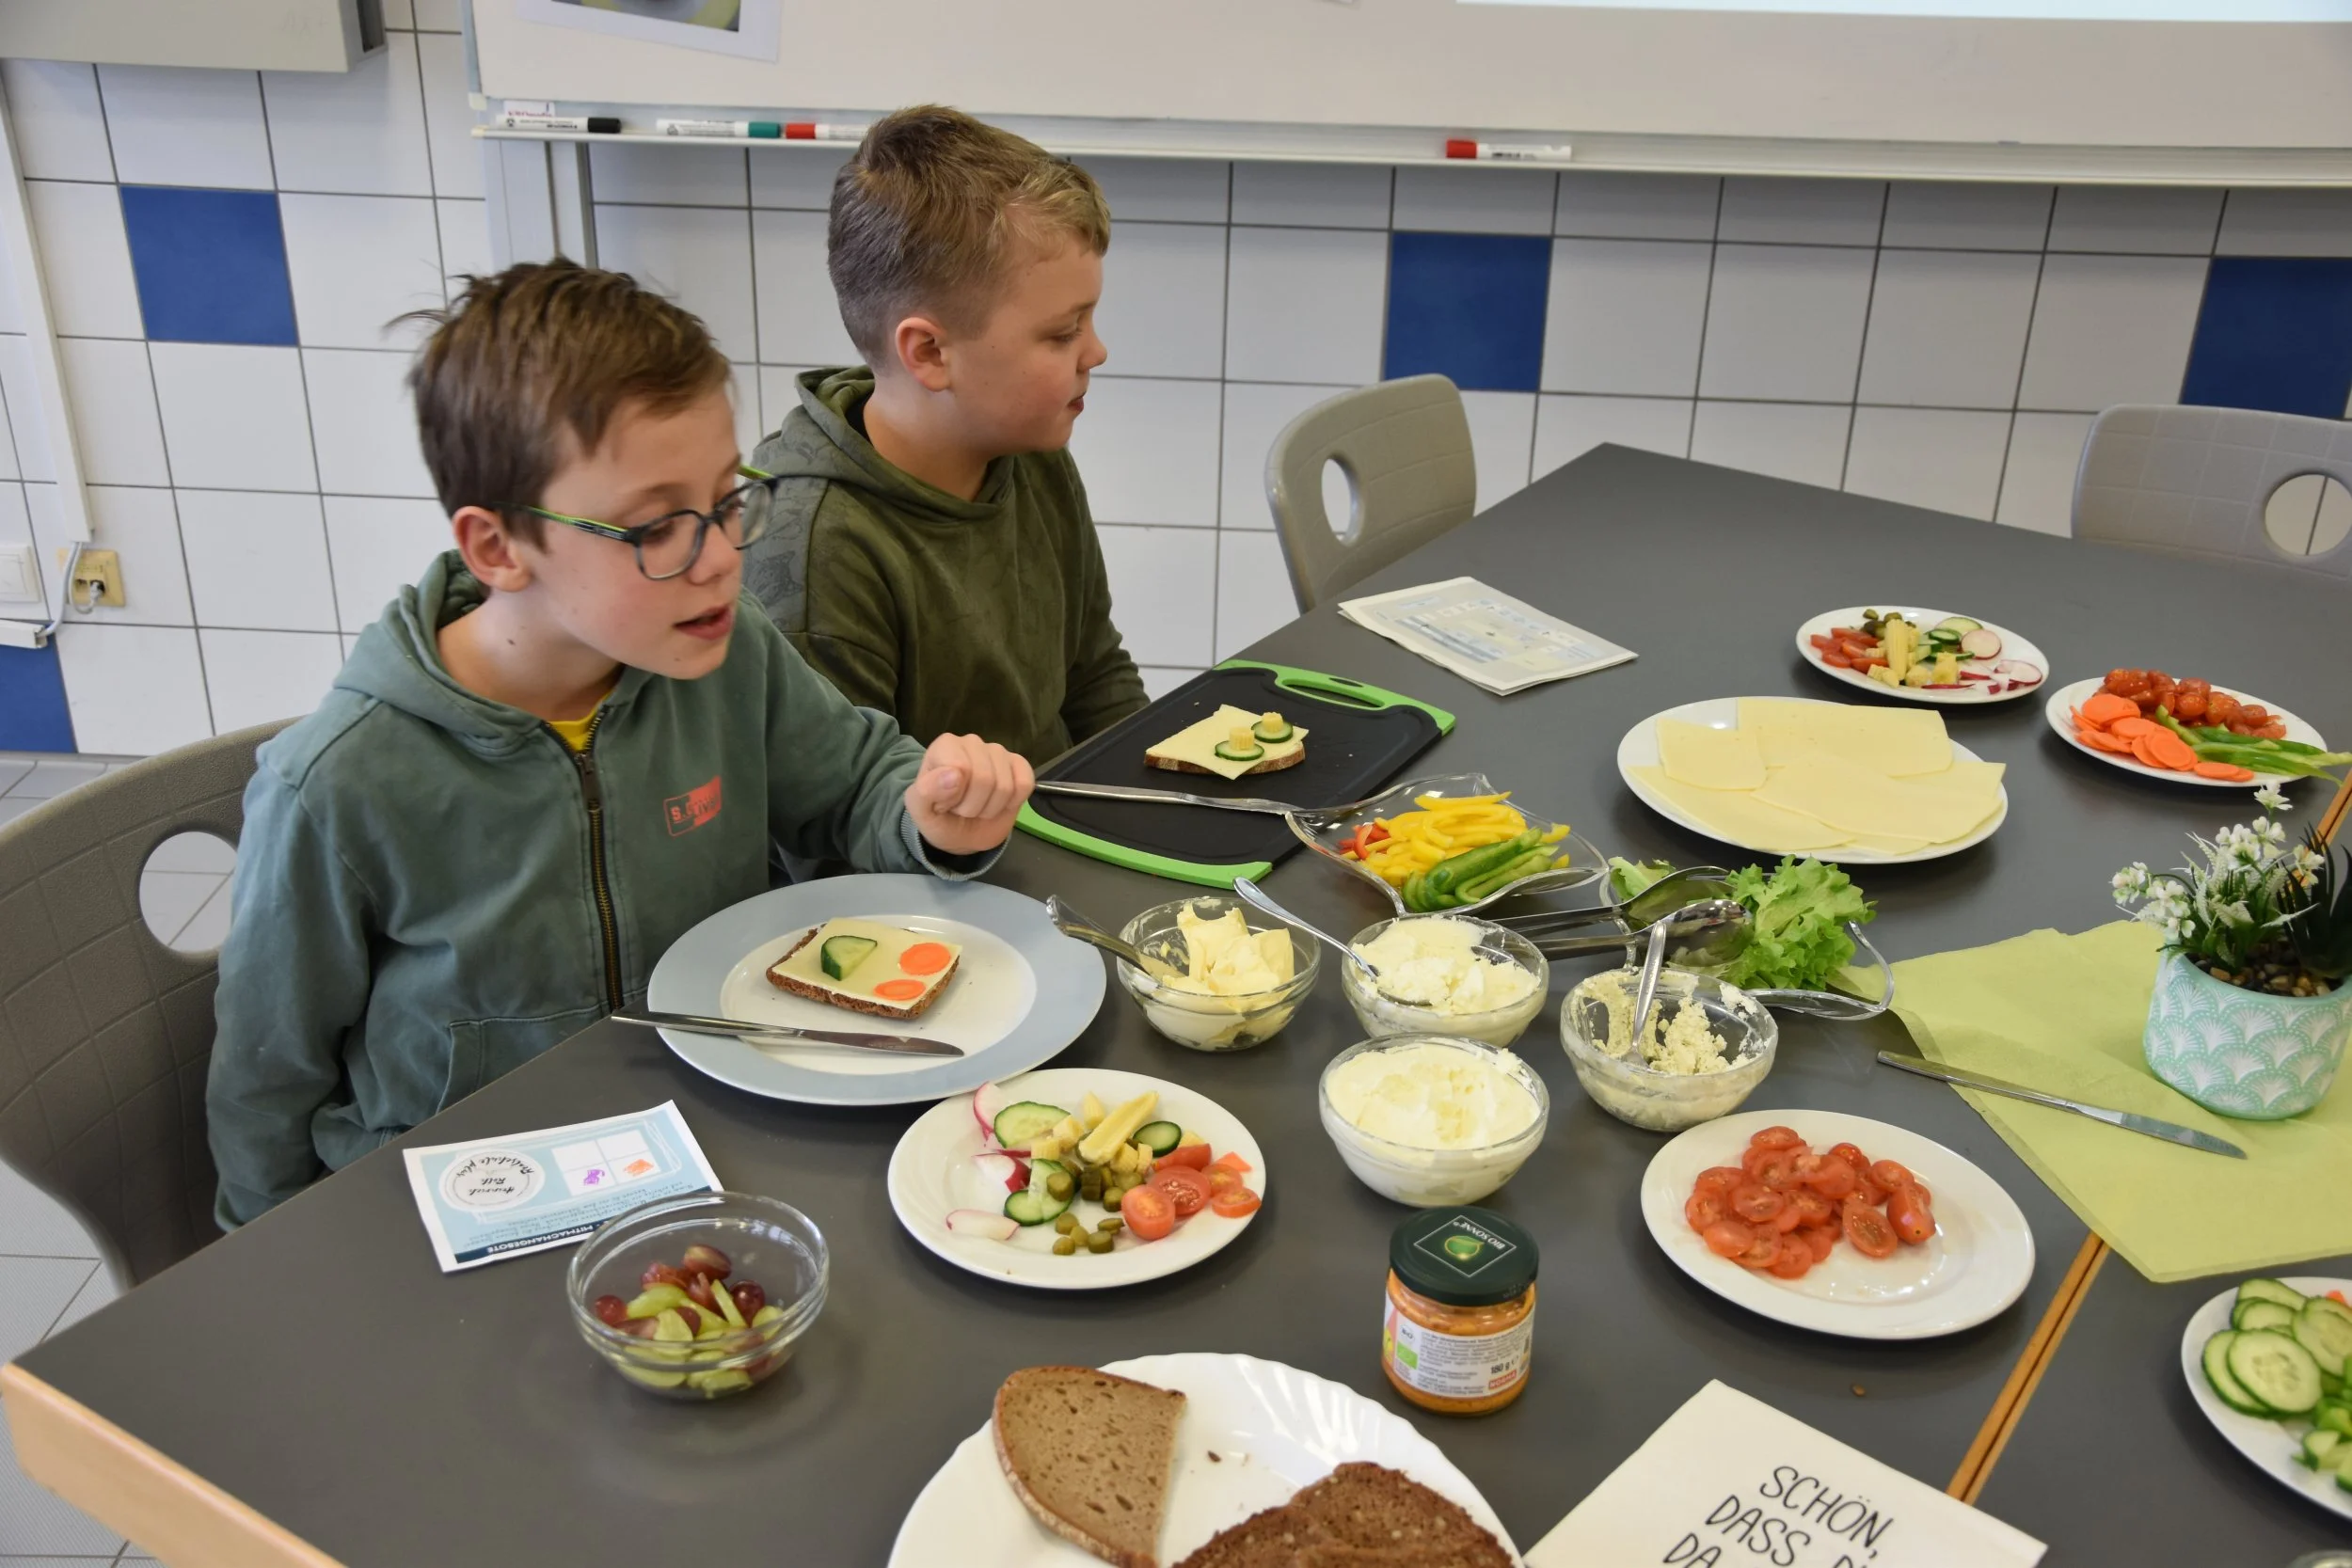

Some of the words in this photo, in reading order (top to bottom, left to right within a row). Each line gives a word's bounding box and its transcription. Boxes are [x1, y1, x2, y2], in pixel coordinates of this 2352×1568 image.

[486, 1225, 594, 1254] MITMACHANGEBOTE
[1487, 1237, 1505, 1250] BIO
[1705, 1494, 1812, 1567] DASS
[1759, 1465, 1894, 1560] SCHÖN,
[1662, 1532, 1722, 1568] DA
